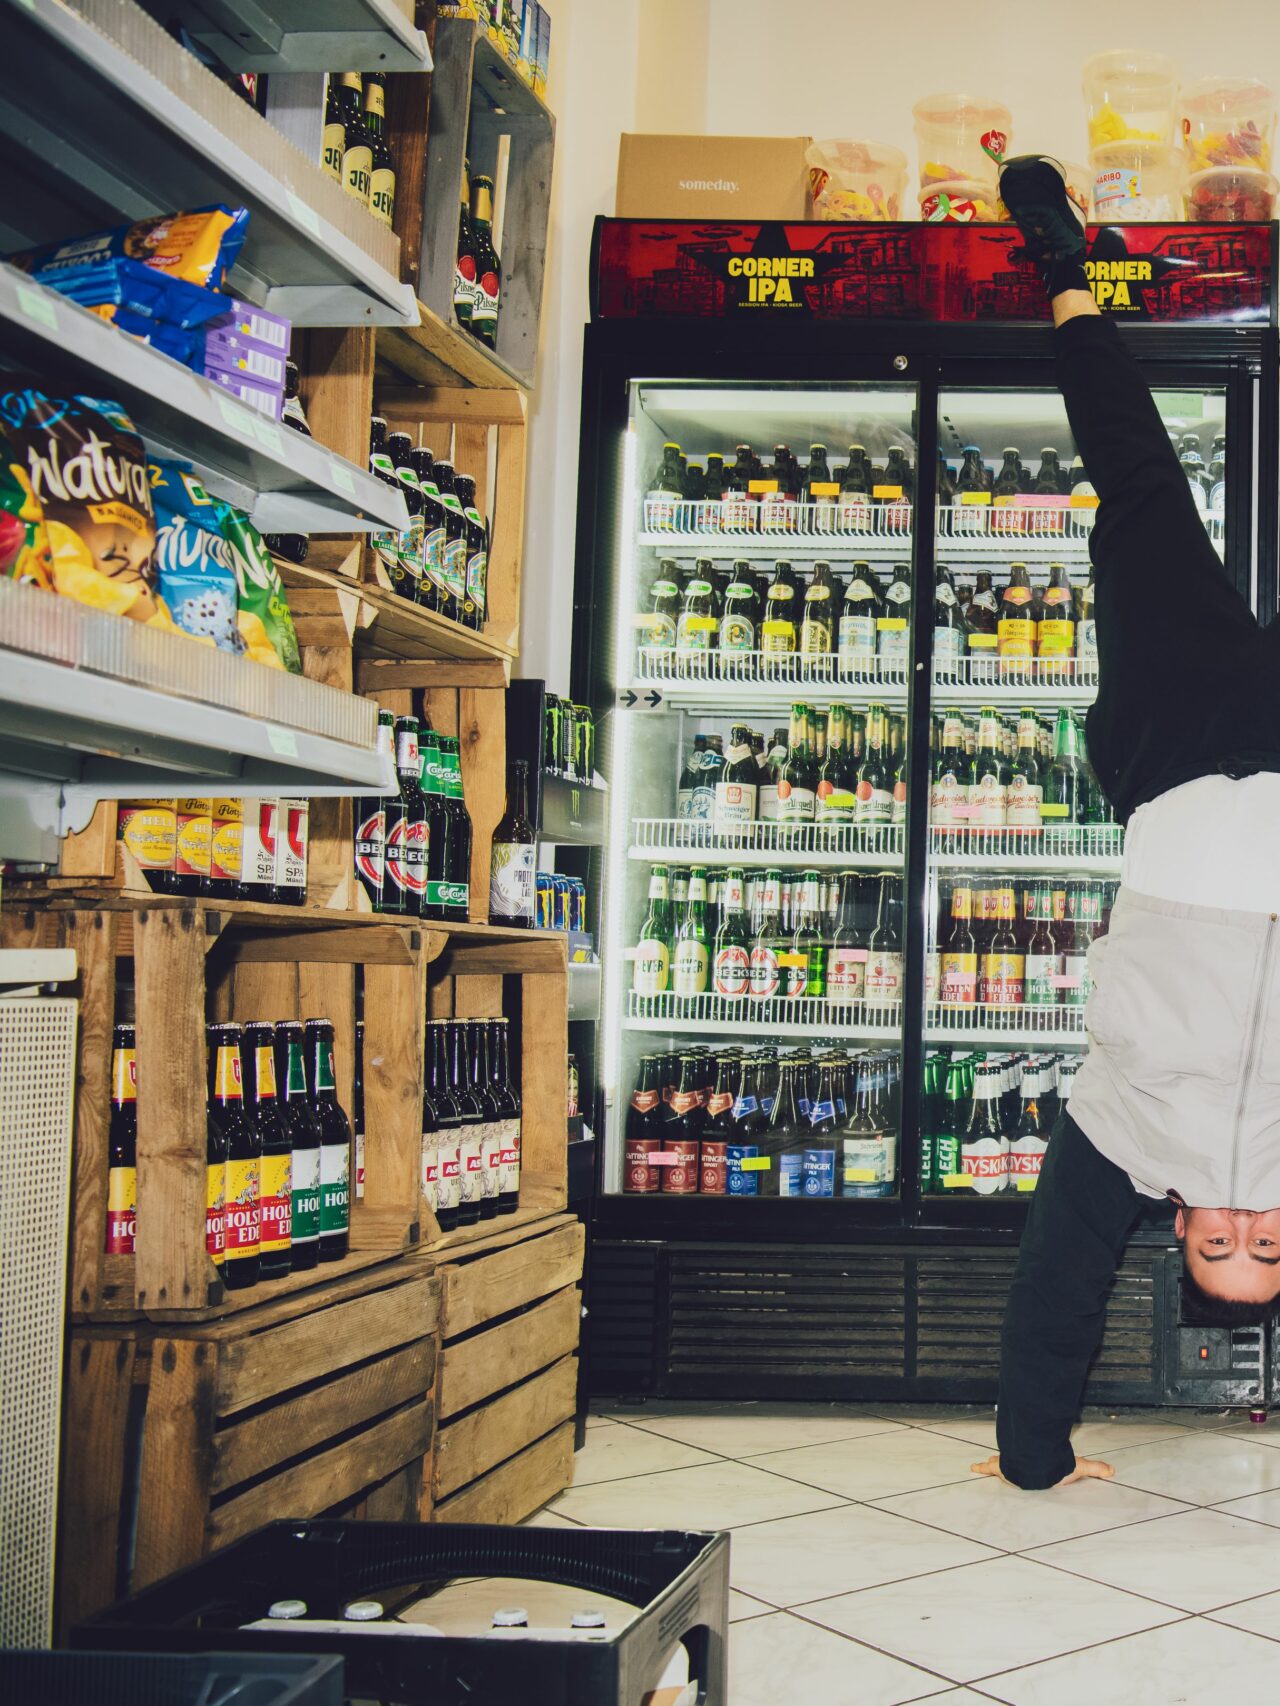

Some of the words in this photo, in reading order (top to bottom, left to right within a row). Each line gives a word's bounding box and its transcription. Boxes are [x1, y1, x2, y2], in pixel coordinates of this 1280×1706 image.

[679, 178, 740, 193] someday.
[728, 257, 815, 278] CORNER
[749, 278, 793, 302] IPA
